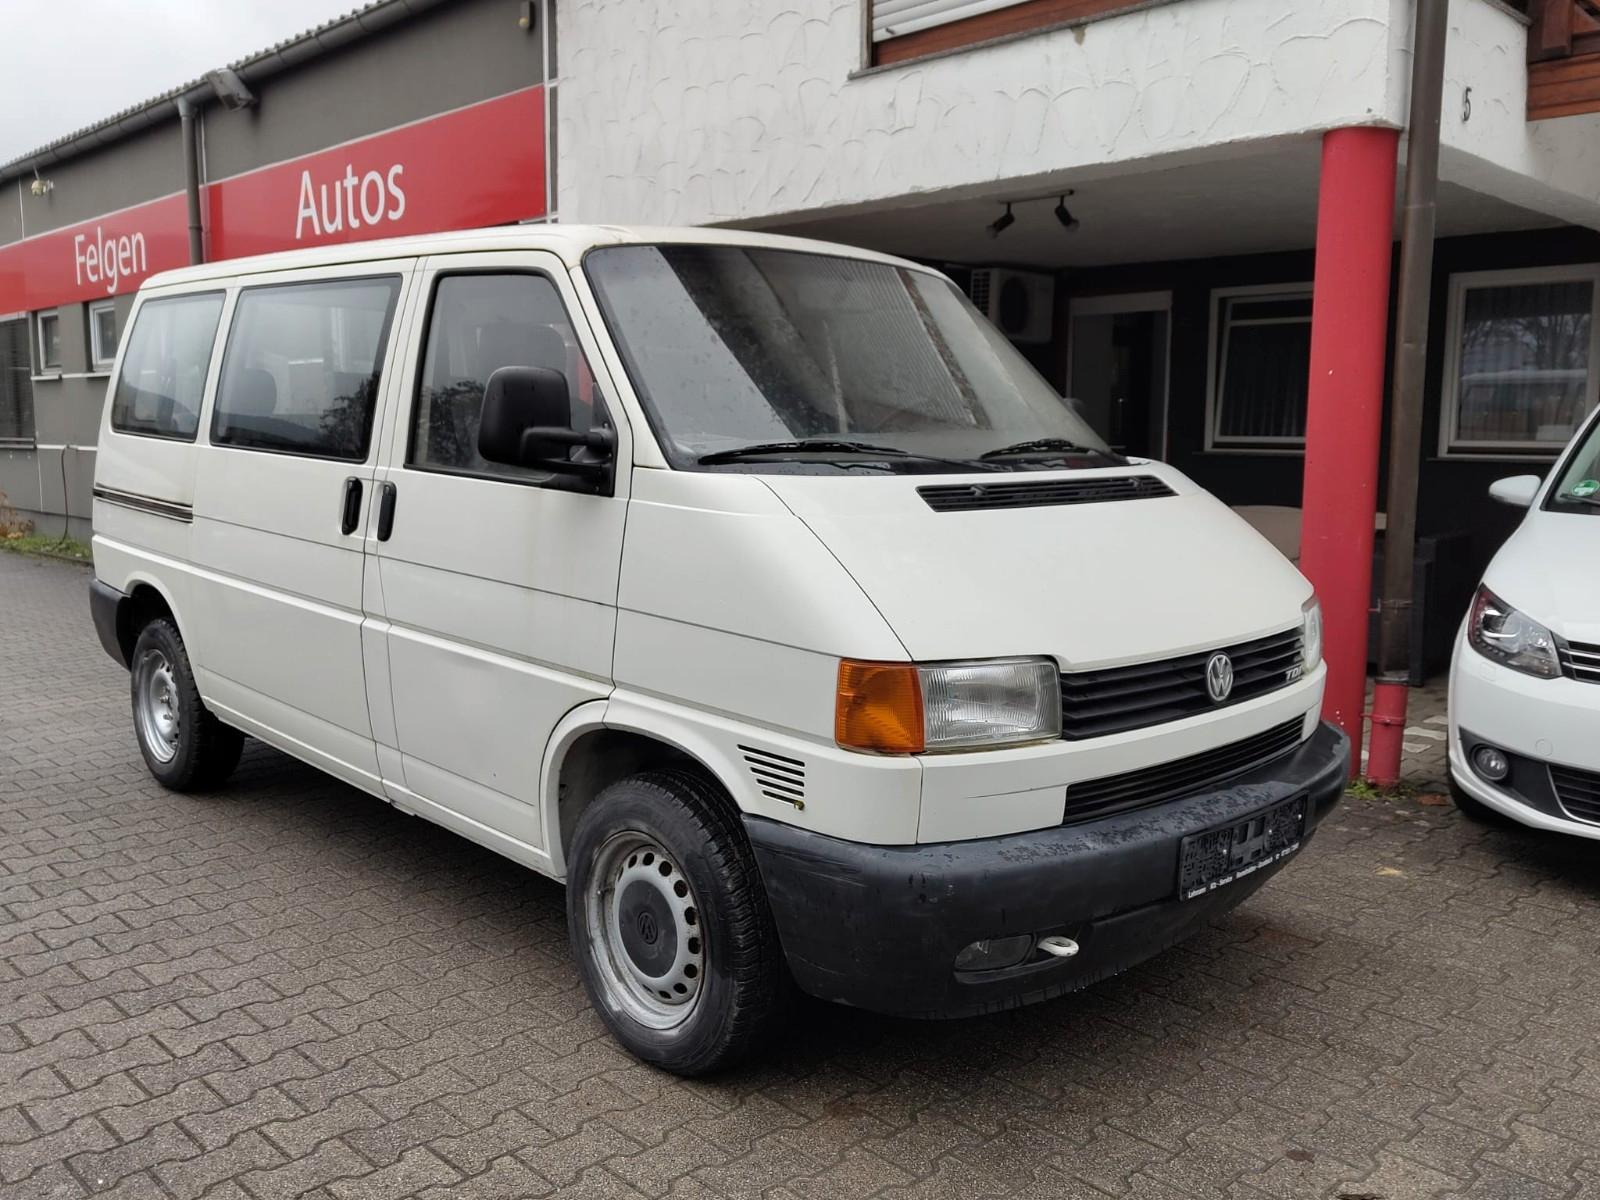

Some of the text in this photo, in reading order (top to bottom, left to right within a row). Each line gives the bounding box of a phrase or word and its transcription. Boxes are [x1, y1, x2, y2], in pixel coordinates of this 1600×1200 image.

[1463, 87, 1472, 122] 5
[296, 163, 406, 240] Autos
[76, 227, 147, 293] Felgen
